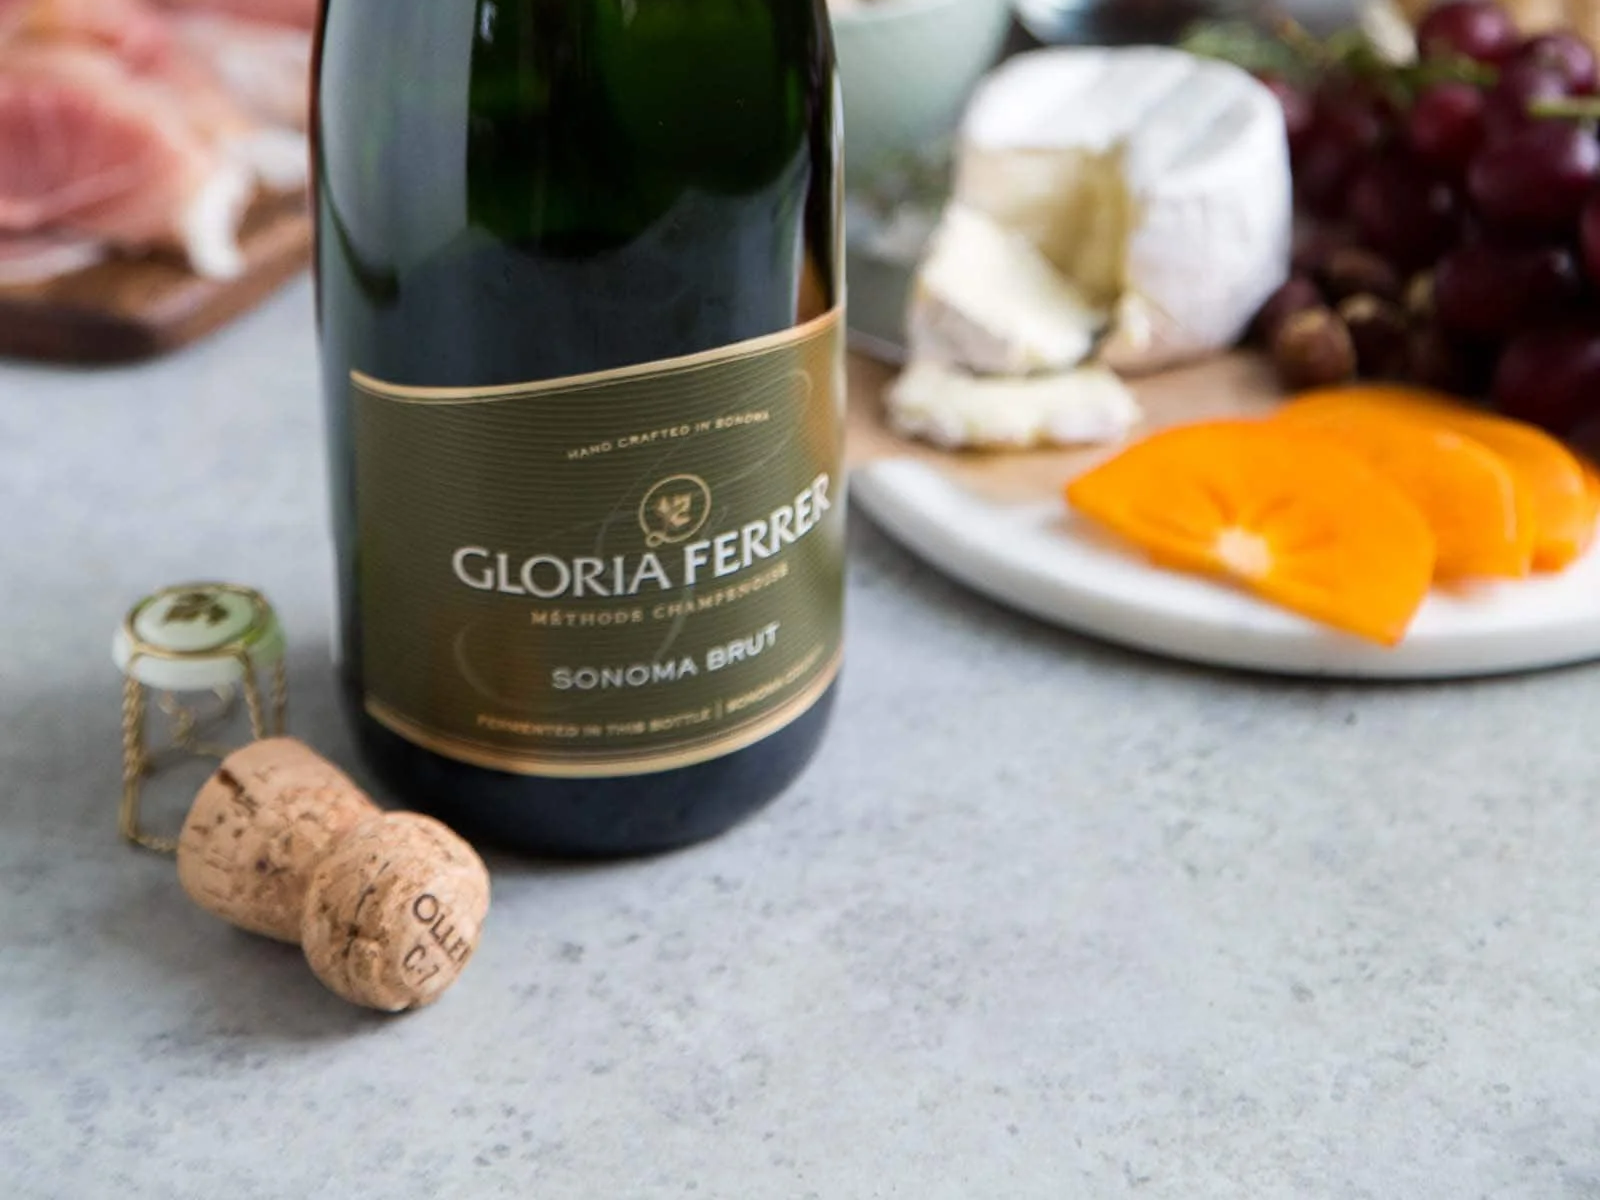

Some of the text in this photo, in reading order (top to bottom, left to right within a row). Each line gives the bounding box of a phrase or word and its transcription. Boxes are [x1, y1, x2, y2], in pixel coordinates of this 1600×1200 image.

[567, 409, 770, 461] HAND CRAFTED IN SONOMA
[452, 472, 831, 599] GLORIA FERRER
[551, 656, 698, 690] SONOMA
[706, 620, 781, 672] BRUT
